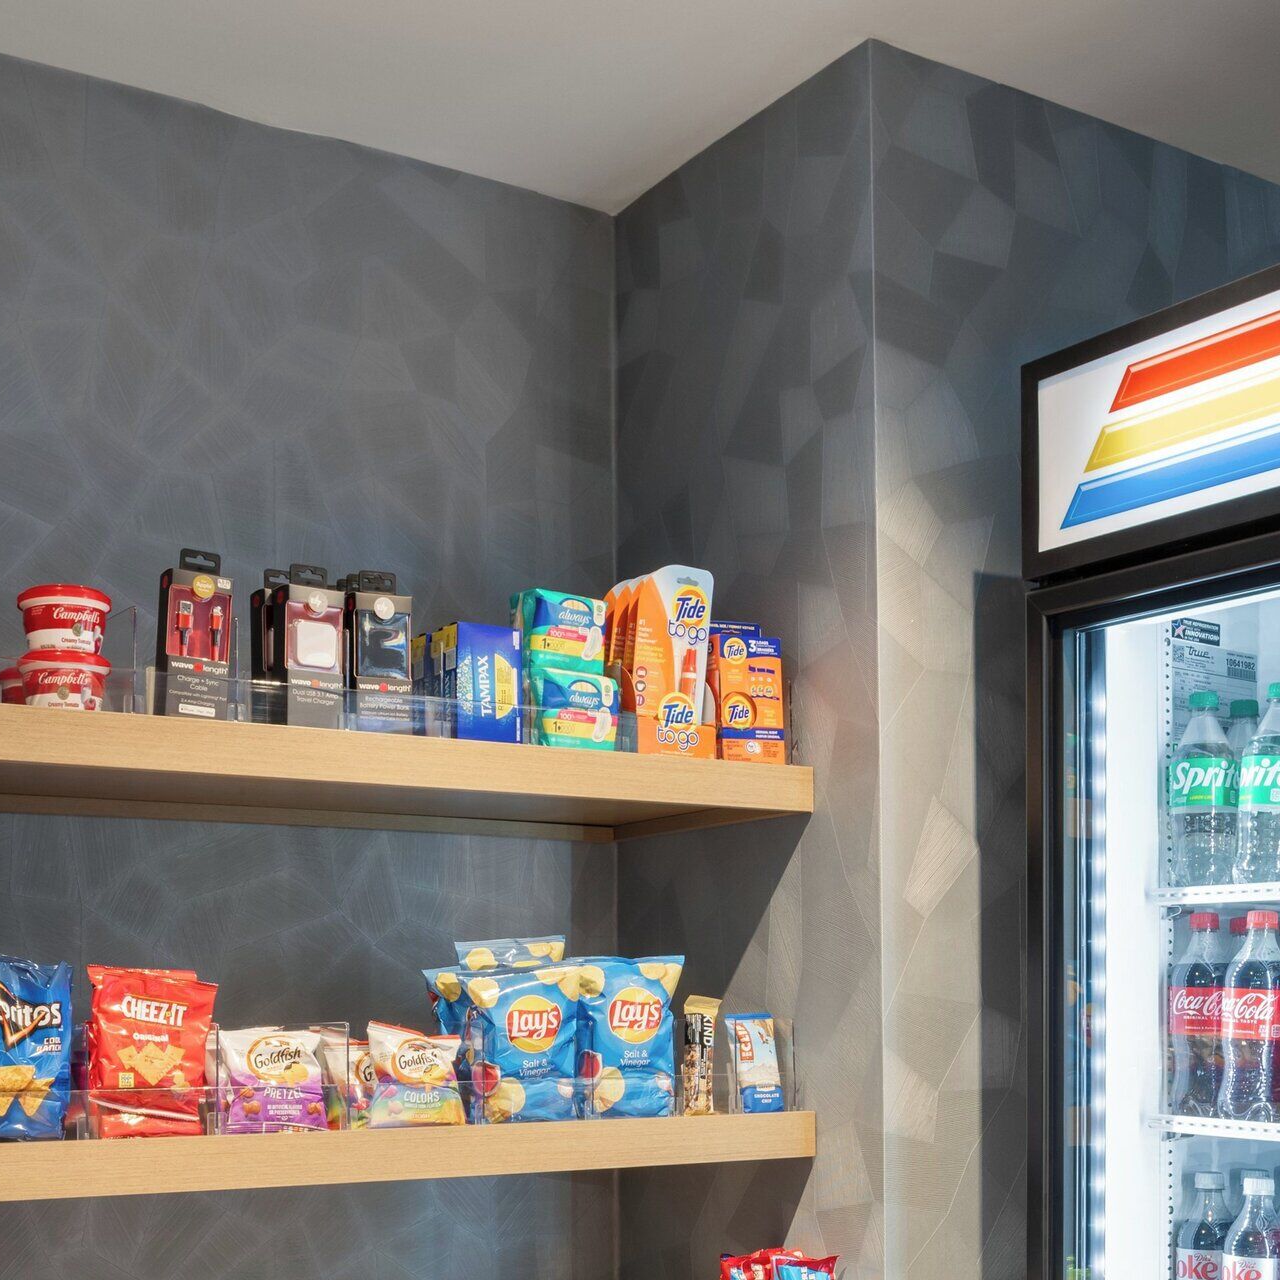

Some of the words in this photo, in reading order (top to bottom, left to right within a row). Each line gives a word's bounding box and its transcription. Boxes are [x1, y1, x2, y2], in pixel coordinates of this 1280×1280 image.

[559, 609, 591, 626] always
[676, 597, 705, 621] Tide
[668, 619, 686, 637] to
[687, 626, 707, 645] go
[1185, 630, 1219, 640] INNOVATION
[727, 643, 745, 659] Tide
[177, 674, 199, 683] Charge
[206, 678, 219, 686] Sync
[190, 683, 208, 691] Cable
[477, 655, 492, 717] TAMPAX
[312, 697, 335, 705] Charger
[569, 693, 600, 708] always
[663, 703, 694, 727] Tide
[728, 705, 749, 723] Tide
[657, 727, 675, 743] to
[677, 731, 698, 750] go
[613, 1000, 661, 1031] Lay's
[512, 1009, 559, 1040] Lay's
[703, 1015, 712, 1046] KIND
[254, 1048, 302, 1069] Goldfish
[624, 1049, 640, 1059] Salt
[522, 1059, 540, 1068] Salt
[404, 1090, 441, 1104] COLORS
